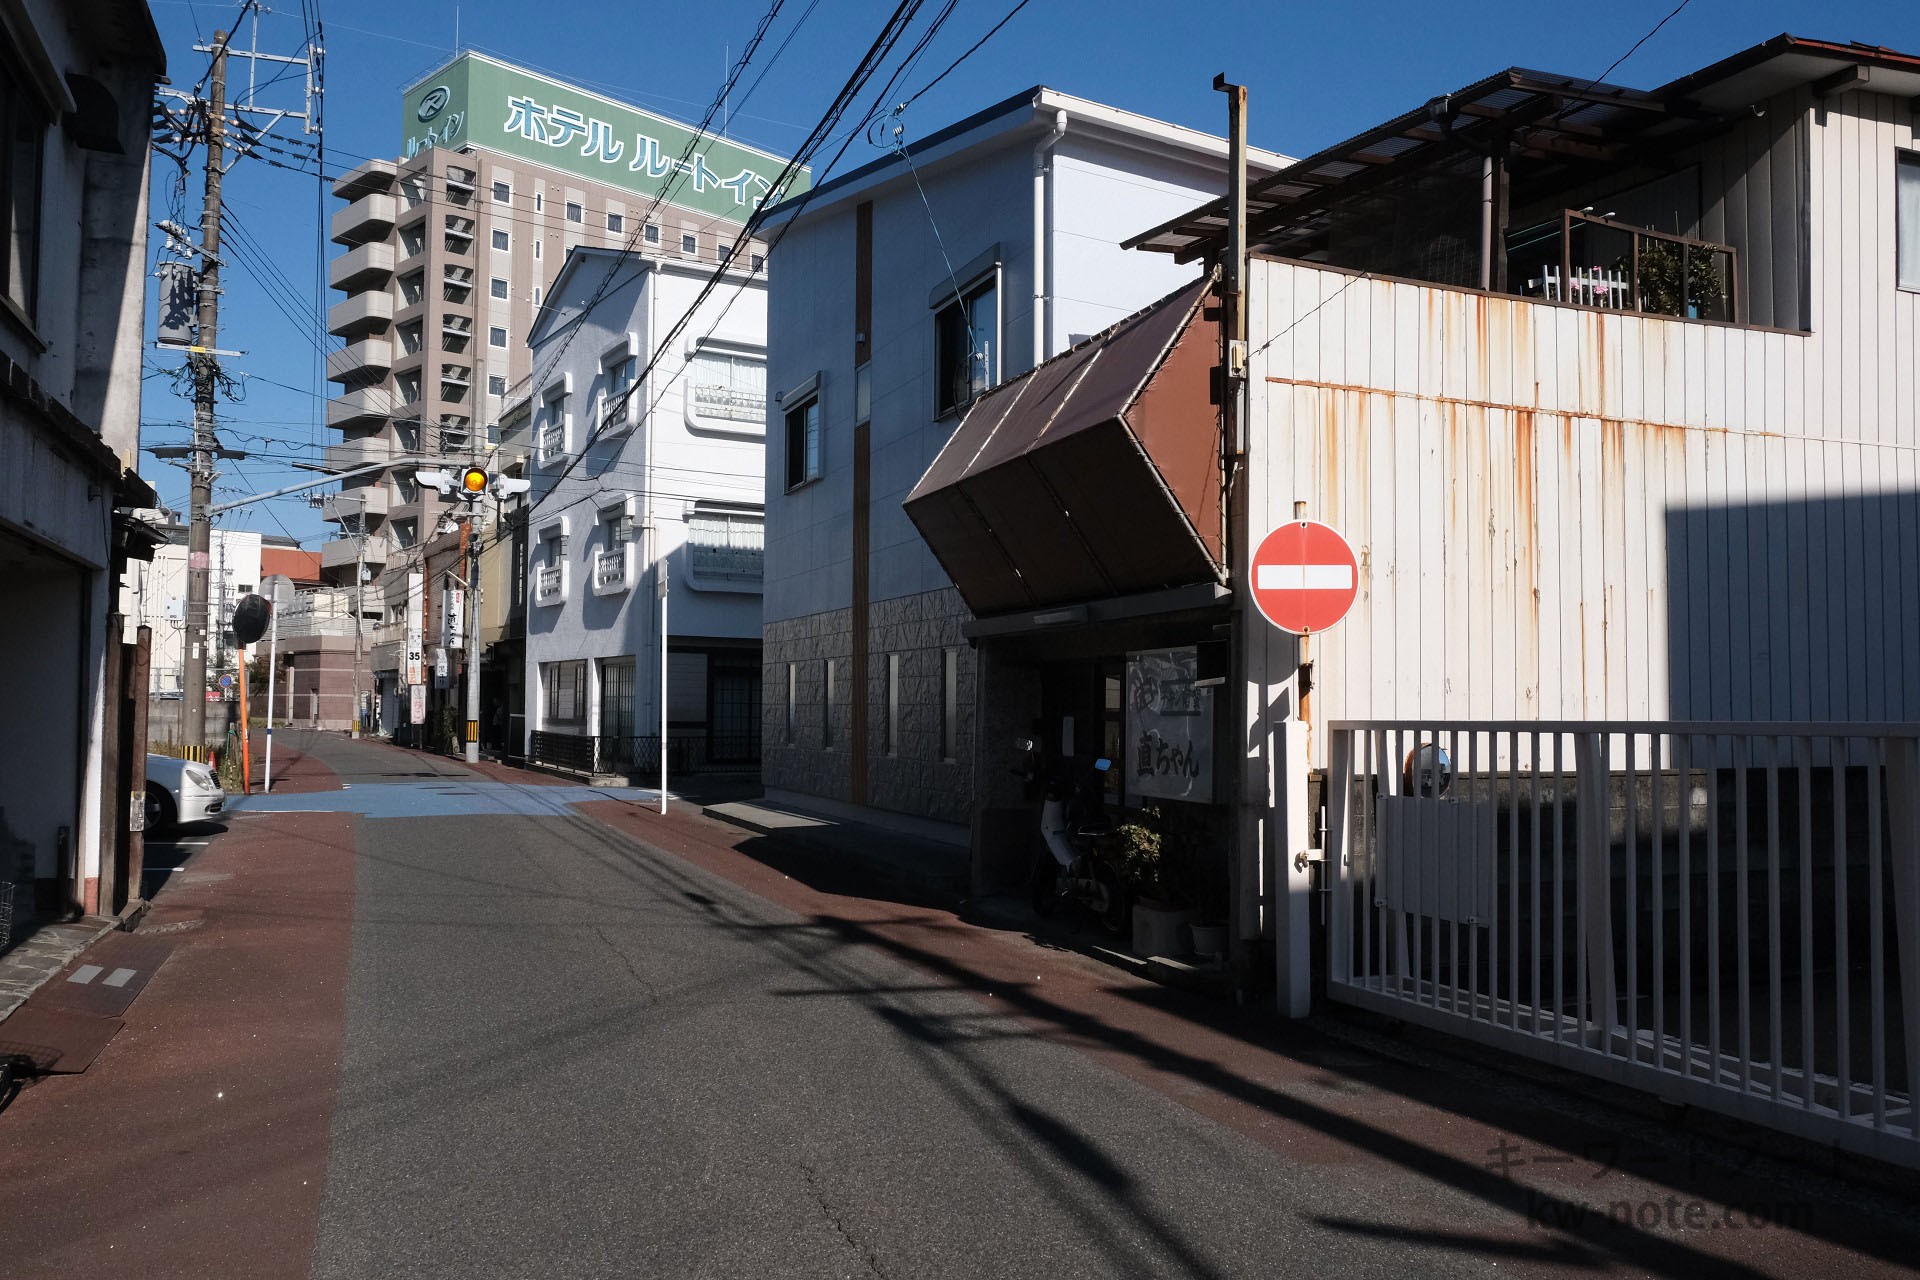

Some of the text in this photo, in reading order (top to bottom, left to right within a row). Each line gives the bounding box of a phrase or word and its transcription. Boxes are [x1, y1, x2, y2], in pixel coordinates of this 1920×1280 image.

[505, 95, 623, 163] ホテル
[409, 652, 421, 661] 35
